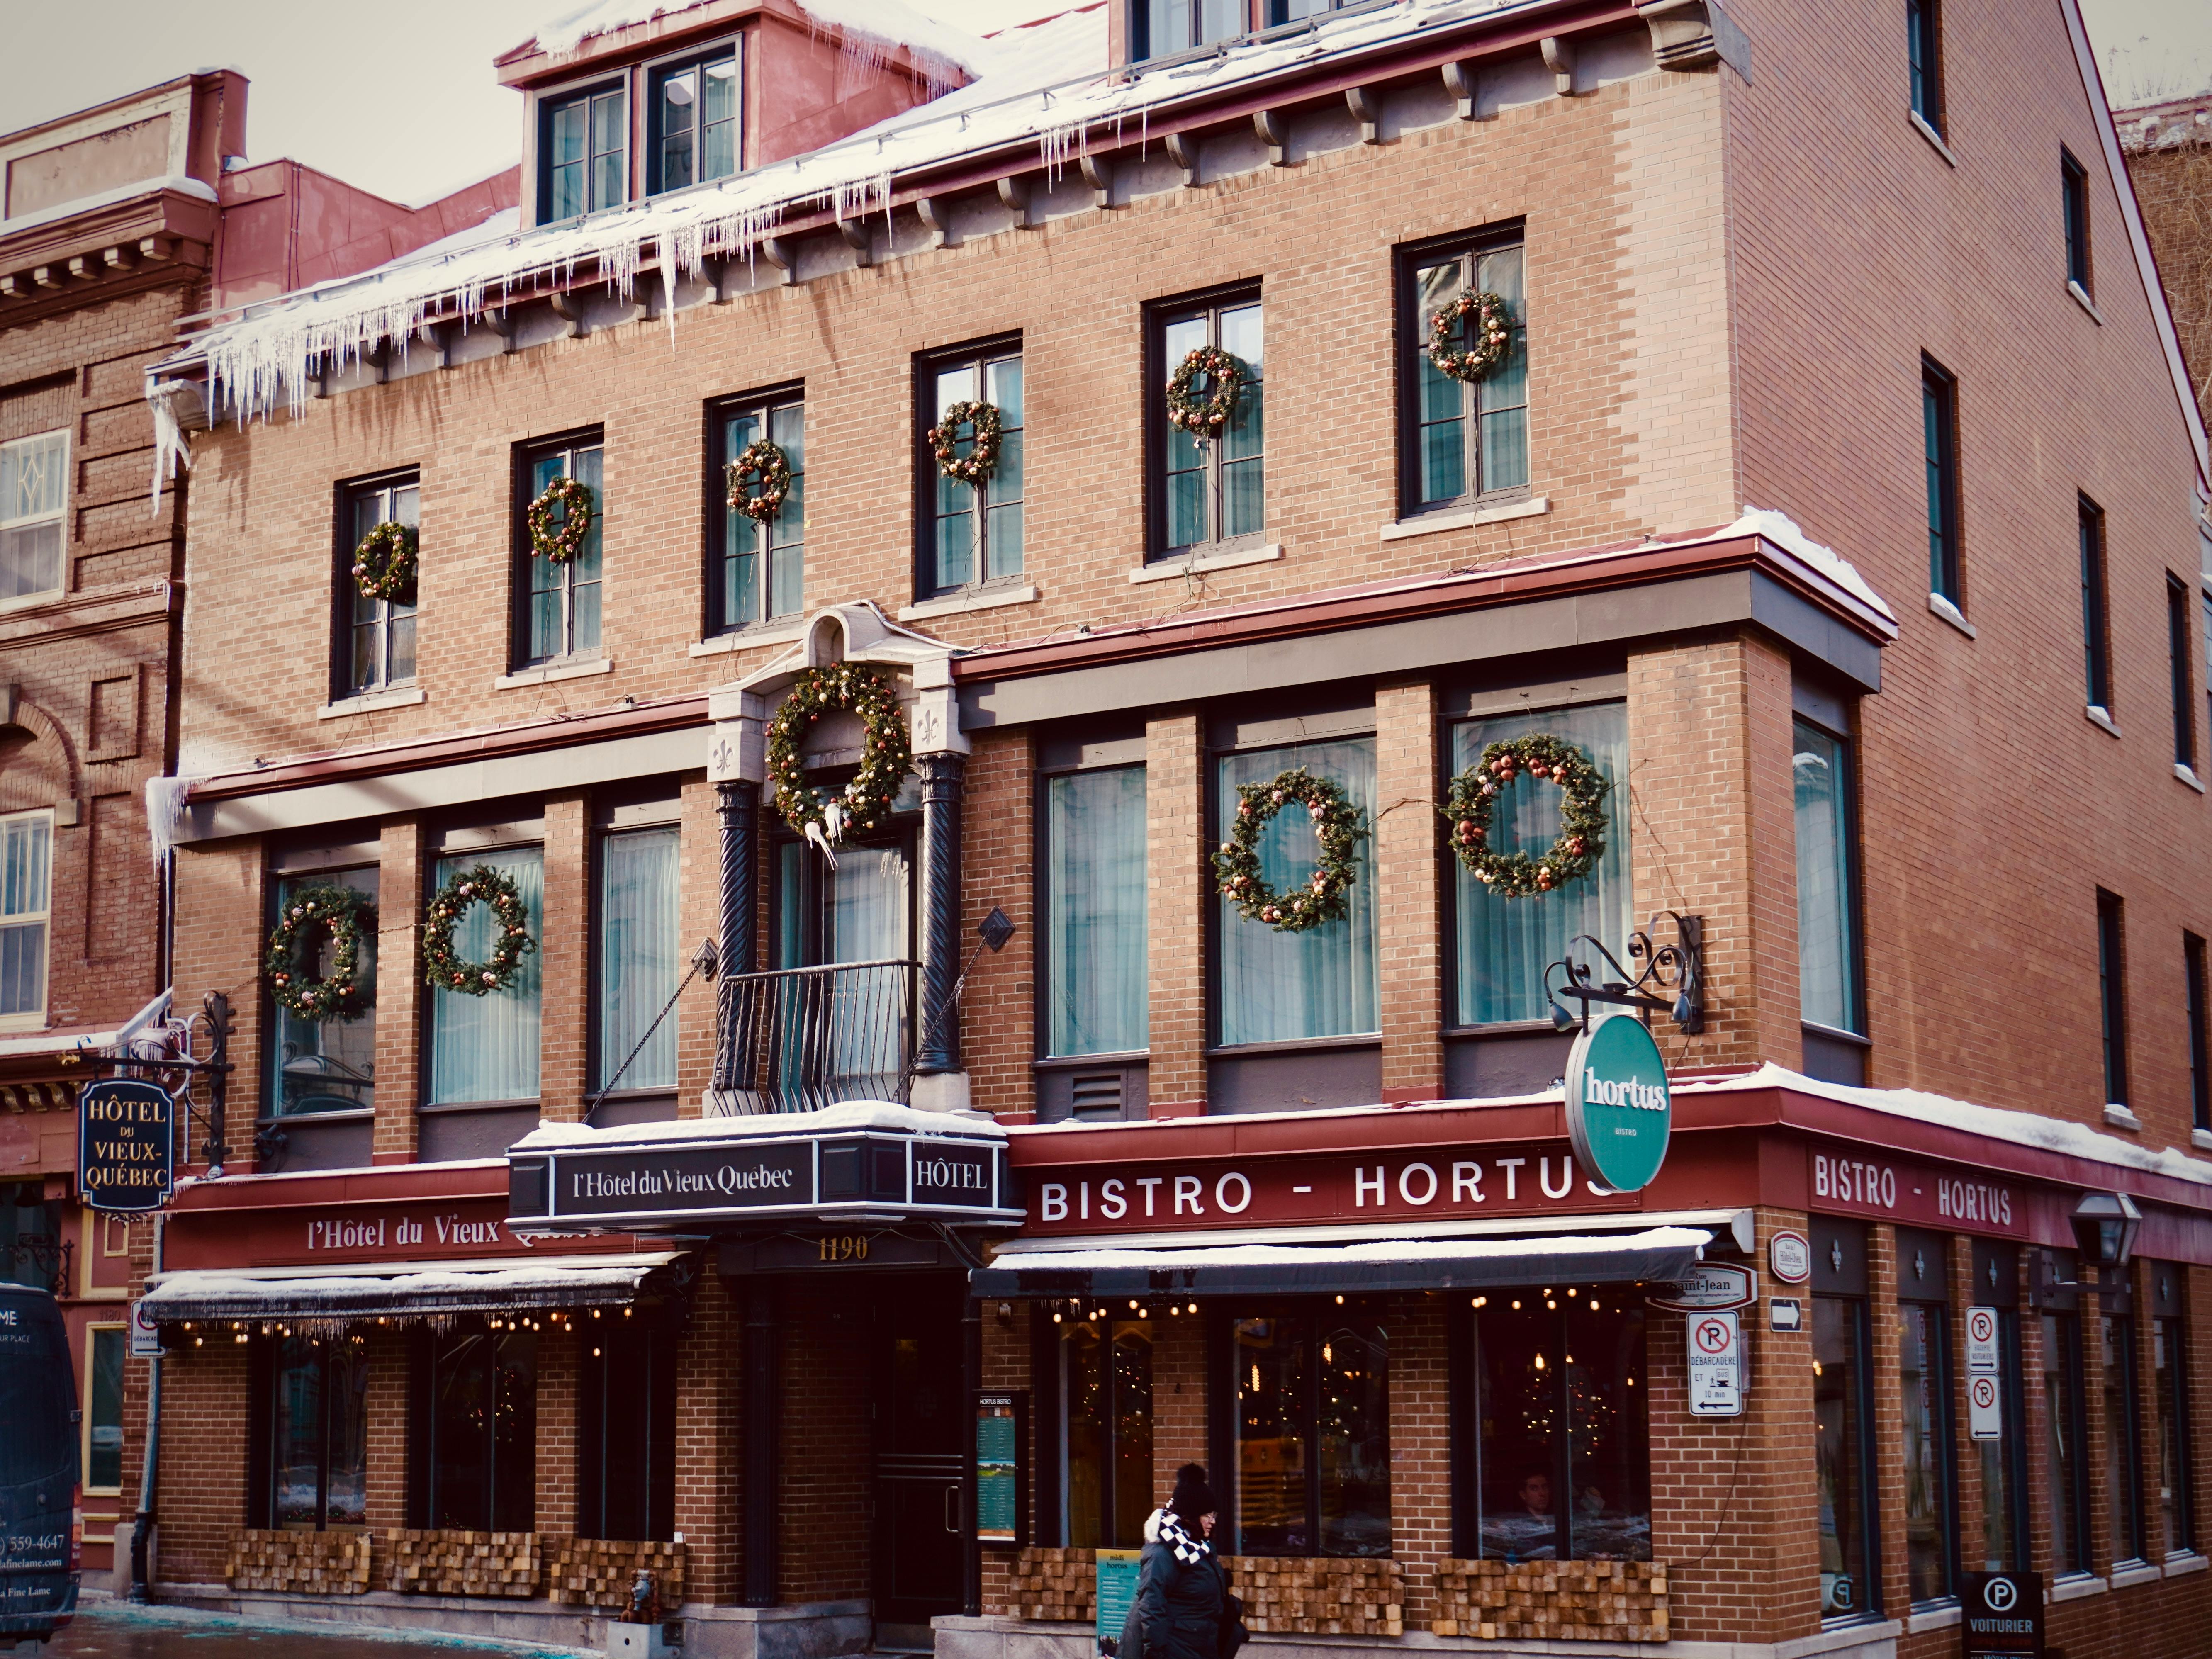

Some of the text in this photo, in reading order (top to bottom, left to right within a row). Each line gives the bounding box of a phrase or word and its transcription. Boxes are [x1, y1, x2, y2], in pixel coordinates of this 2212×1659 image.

[1585, 1067, 1666, 1111] hortus
[88, 1094, 166, 1122] HÔTEL
[120, 1126, 134, 1138] DU
[1615, 1128, 1637, 1136] BISTRO
[94, 1141, 162, 1161] VIEUX-
[86, 1163, 167, 1190] QUÉBEC
[639, 1170, 662, 1194] du
[662, 1169, 715, 1192] Vieux
[717, 1164, 793, 1195] Québec
[916, 1158, 988, 1189] HÔTEL
[1042, 1172, 1251, 1221] BISTRO
[1355, 1156, 1615, 1207] HORTU
[1815, 1155, 1896, 1209] BISTRO
[1938, 1178, 2011, 1225] HORTUS
[396, 1217, 423, 1245] du
[434, 1214, 500, 1244] Vieux
[819, 1236, 867, 1260] 1190
[1673, 1279, 1731, 1292] aint-Jean
[100, 1309, 121, 1321] 1180
[10, 1335, 30, 1343] PLACE
[1691, 1355, 1737, 1365] DÉBARCADÈRE
[10, 1534, 64, 1551] 559-4647
[8, 1587, 26, 1597] Fine
[28, 1586, 51, 1596] Lame
[1970, 1619, 2033, 1633] VOITURIER
